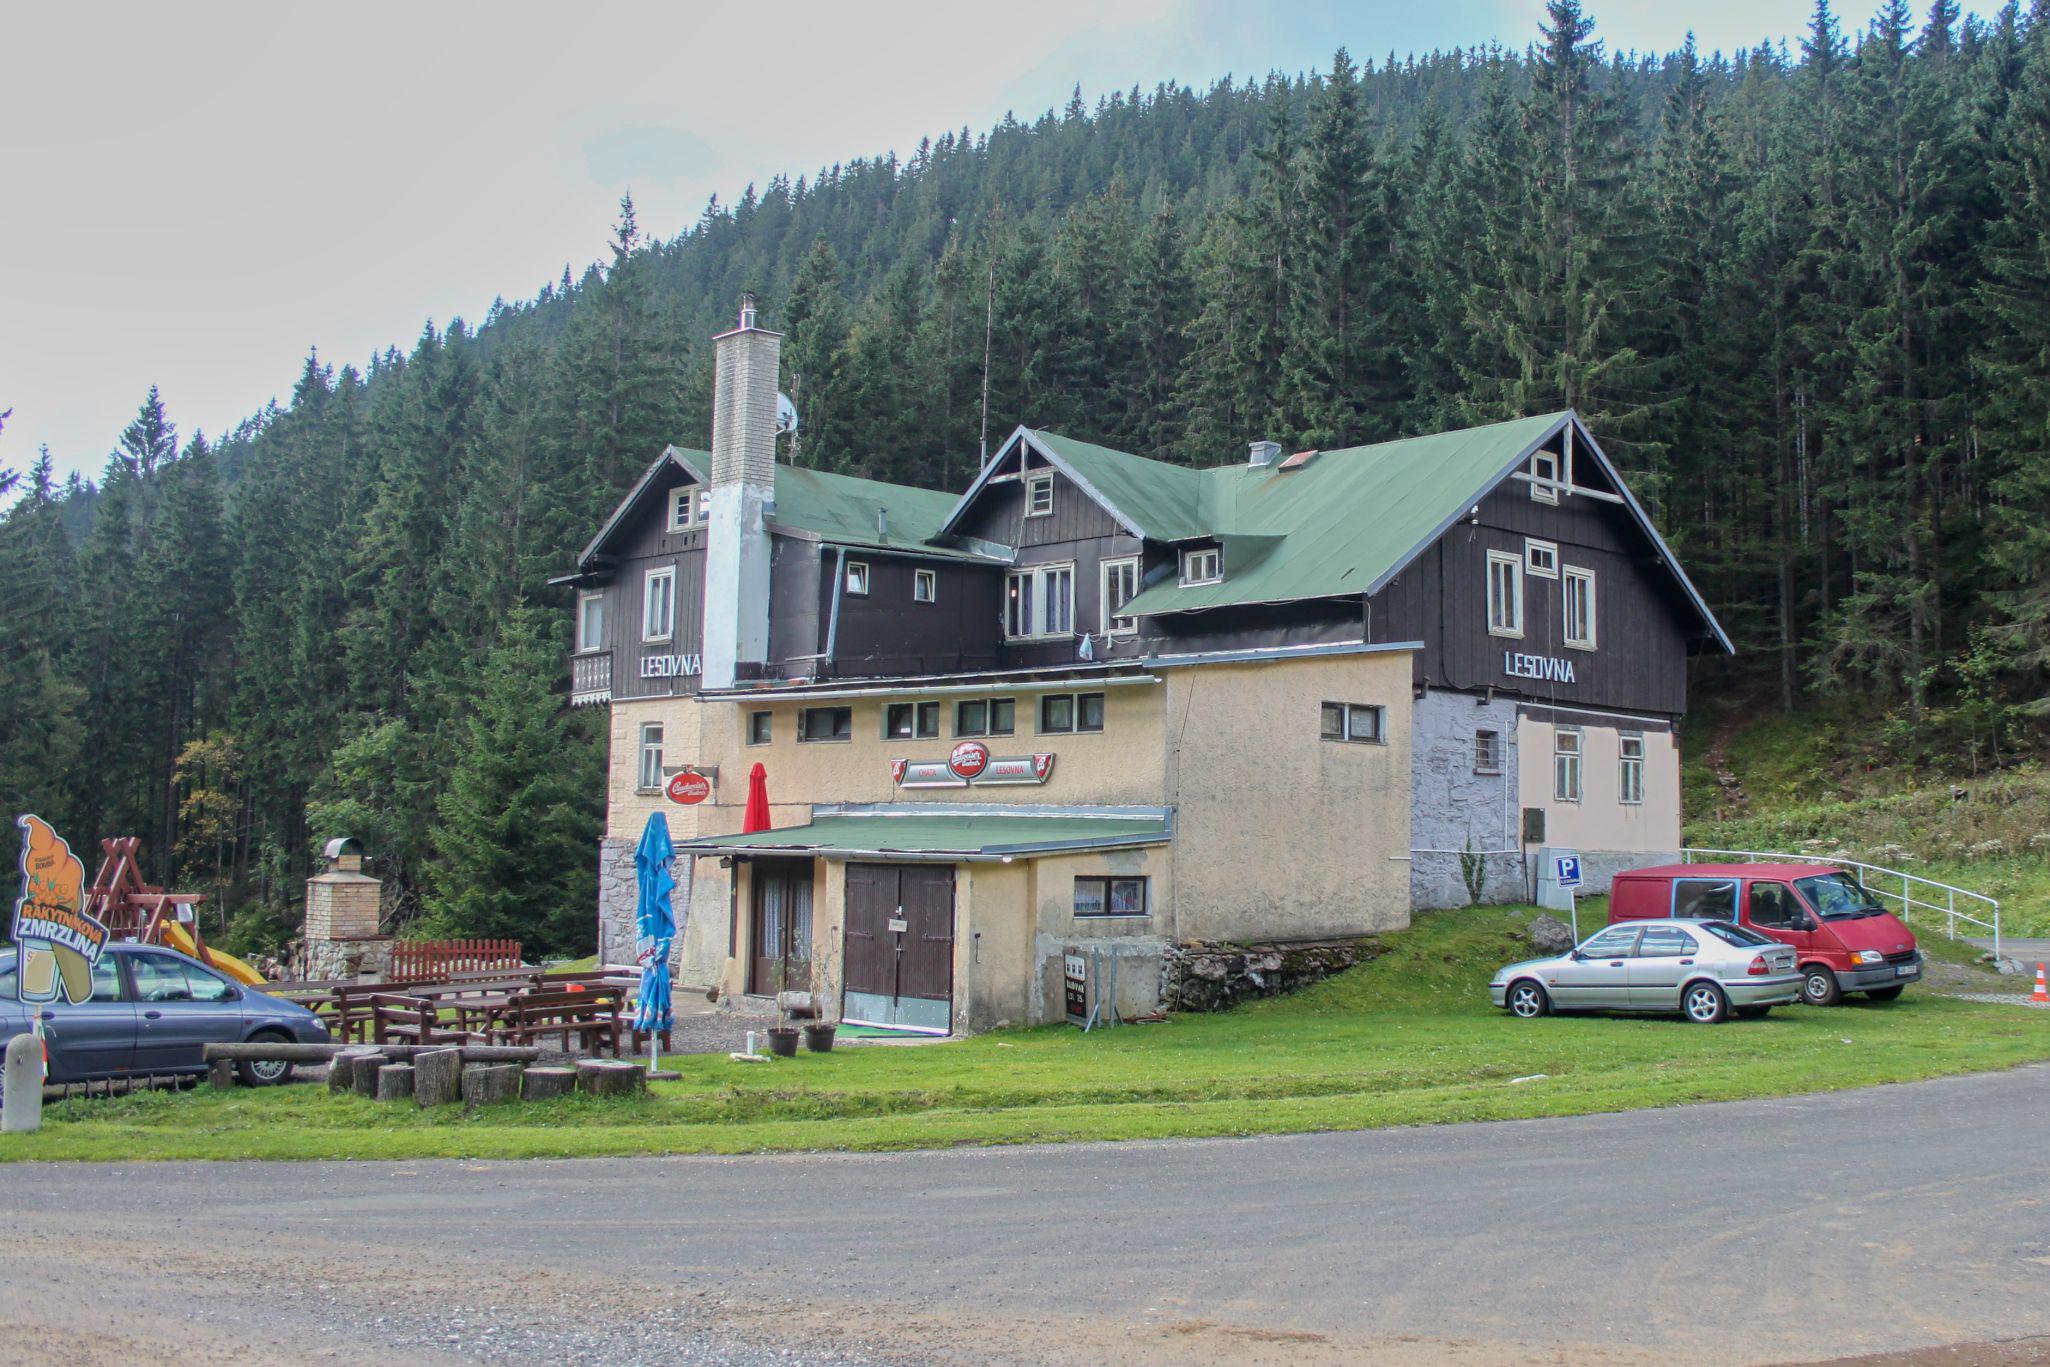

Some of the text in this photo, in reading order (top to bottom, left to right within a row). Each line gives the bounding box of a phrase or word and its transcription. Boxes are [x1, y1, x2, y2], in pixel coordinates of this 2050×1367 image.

[640, 654, 702, 678] LESOVNA
[1504, 651, 1576, 683] LESOVNA
[996, 765, 1025, 775] LESOVNA
[1561, 858, 1574, 876] P
[18, 917, 99, 962] ZMRZLINA
